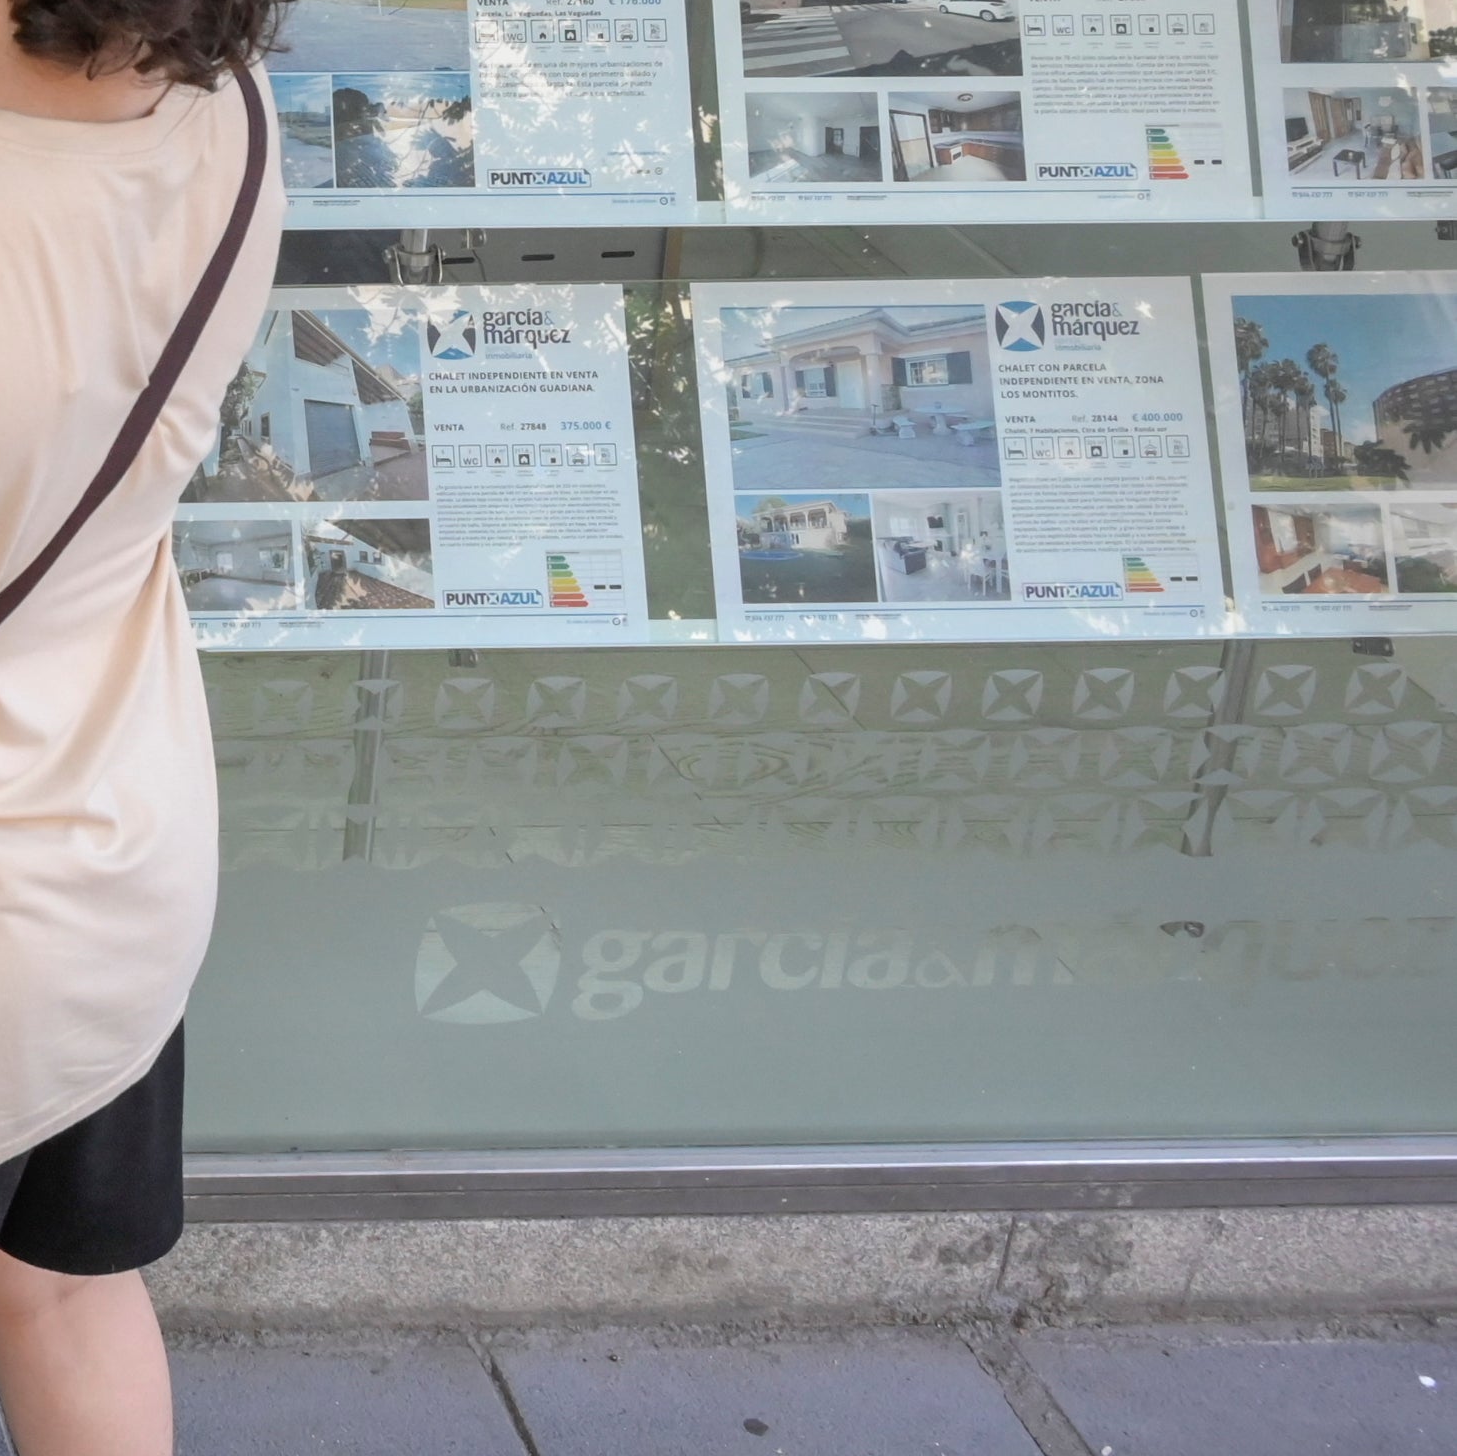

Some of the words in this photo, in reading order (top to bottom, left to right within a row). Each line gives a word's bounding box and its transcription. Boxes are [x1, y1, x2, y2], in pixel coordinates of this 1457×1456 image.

[484, 327, 571, 350] márquez
[1052, 318, 1140, 342] márquez
[429, 385, 443, 394] EN
[445, 385, 458, 394] LA
[460, 382, 537, 394] URBANIZACIÓN
[539, 384, 596, 393] GUADIANA.
[1001, 390, 1020, 399] LOS
[1022, 389, 1079, 399] MONTITOS.
